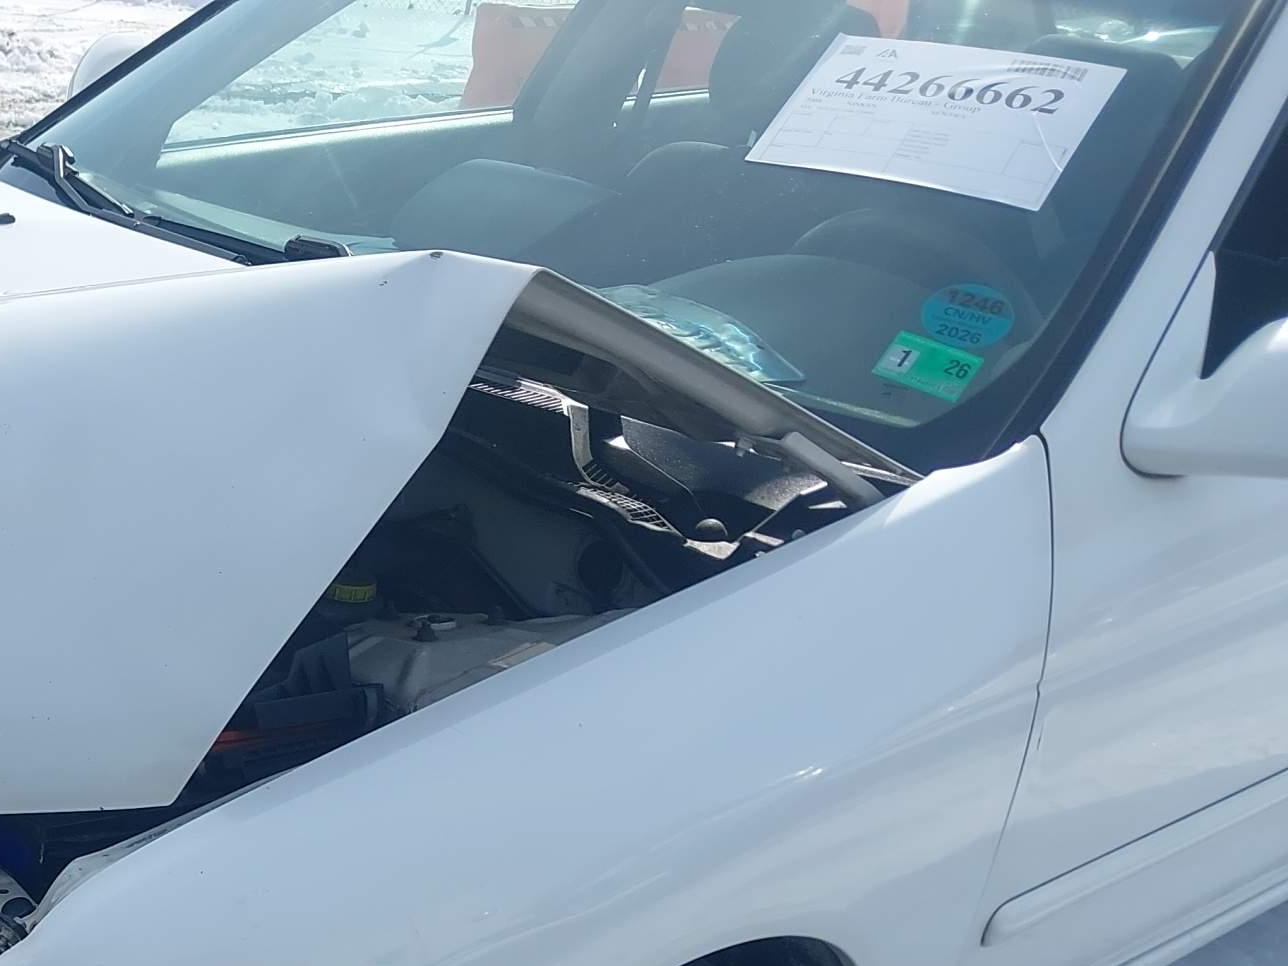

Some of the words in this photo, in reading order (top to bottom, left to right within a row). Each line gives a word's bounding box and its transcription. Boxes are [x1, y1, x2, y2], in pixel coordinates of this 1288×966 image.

[810, 87, 856, 100] Virginia
[835, 67, 1065, 115] 44266662
[947, 287, 1005, 315] 1246
[935, 323, 983, 344] 2026
[896, 349, 913, 368] 1
[943, 359, 972, 380] 26
